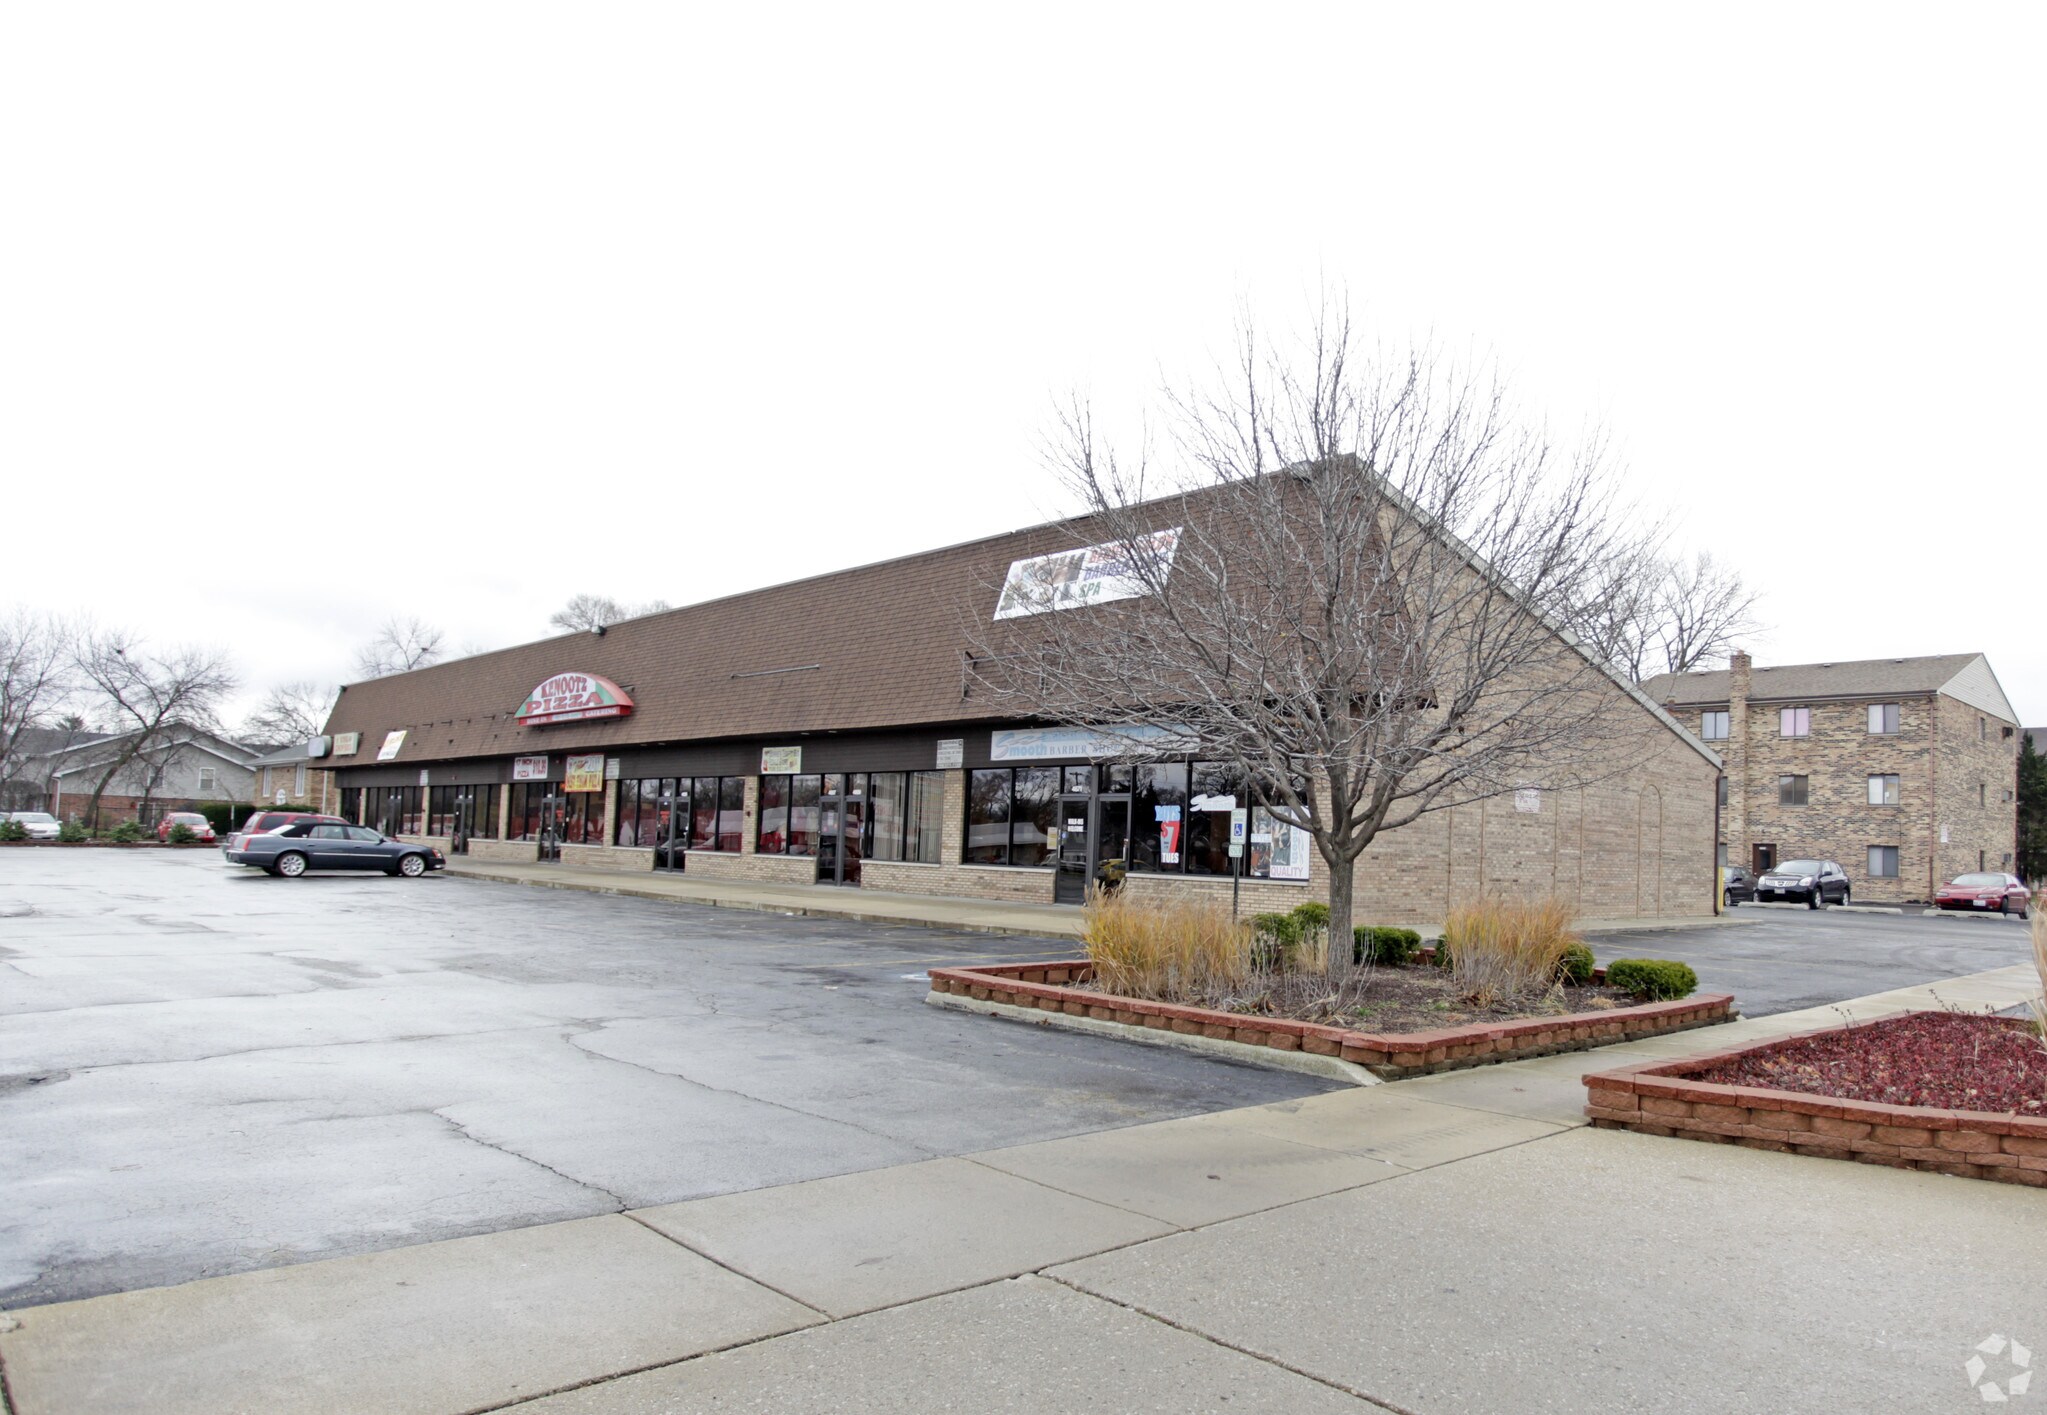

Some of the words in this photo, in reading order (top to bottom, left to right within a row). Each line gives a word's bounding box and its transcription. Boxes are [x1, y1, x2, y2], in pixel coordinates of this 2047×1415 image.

[1079, 581, 1101, 598] SPA
[541, 676, 588, 698] KENOOTZ
[526, 692, 604, 714] PIZZA
[1049, 744, 1087, 756] BARBER
[1161, 852, 1179, 863] TUES
[1270, 866, 1303, 878] QUALITY
